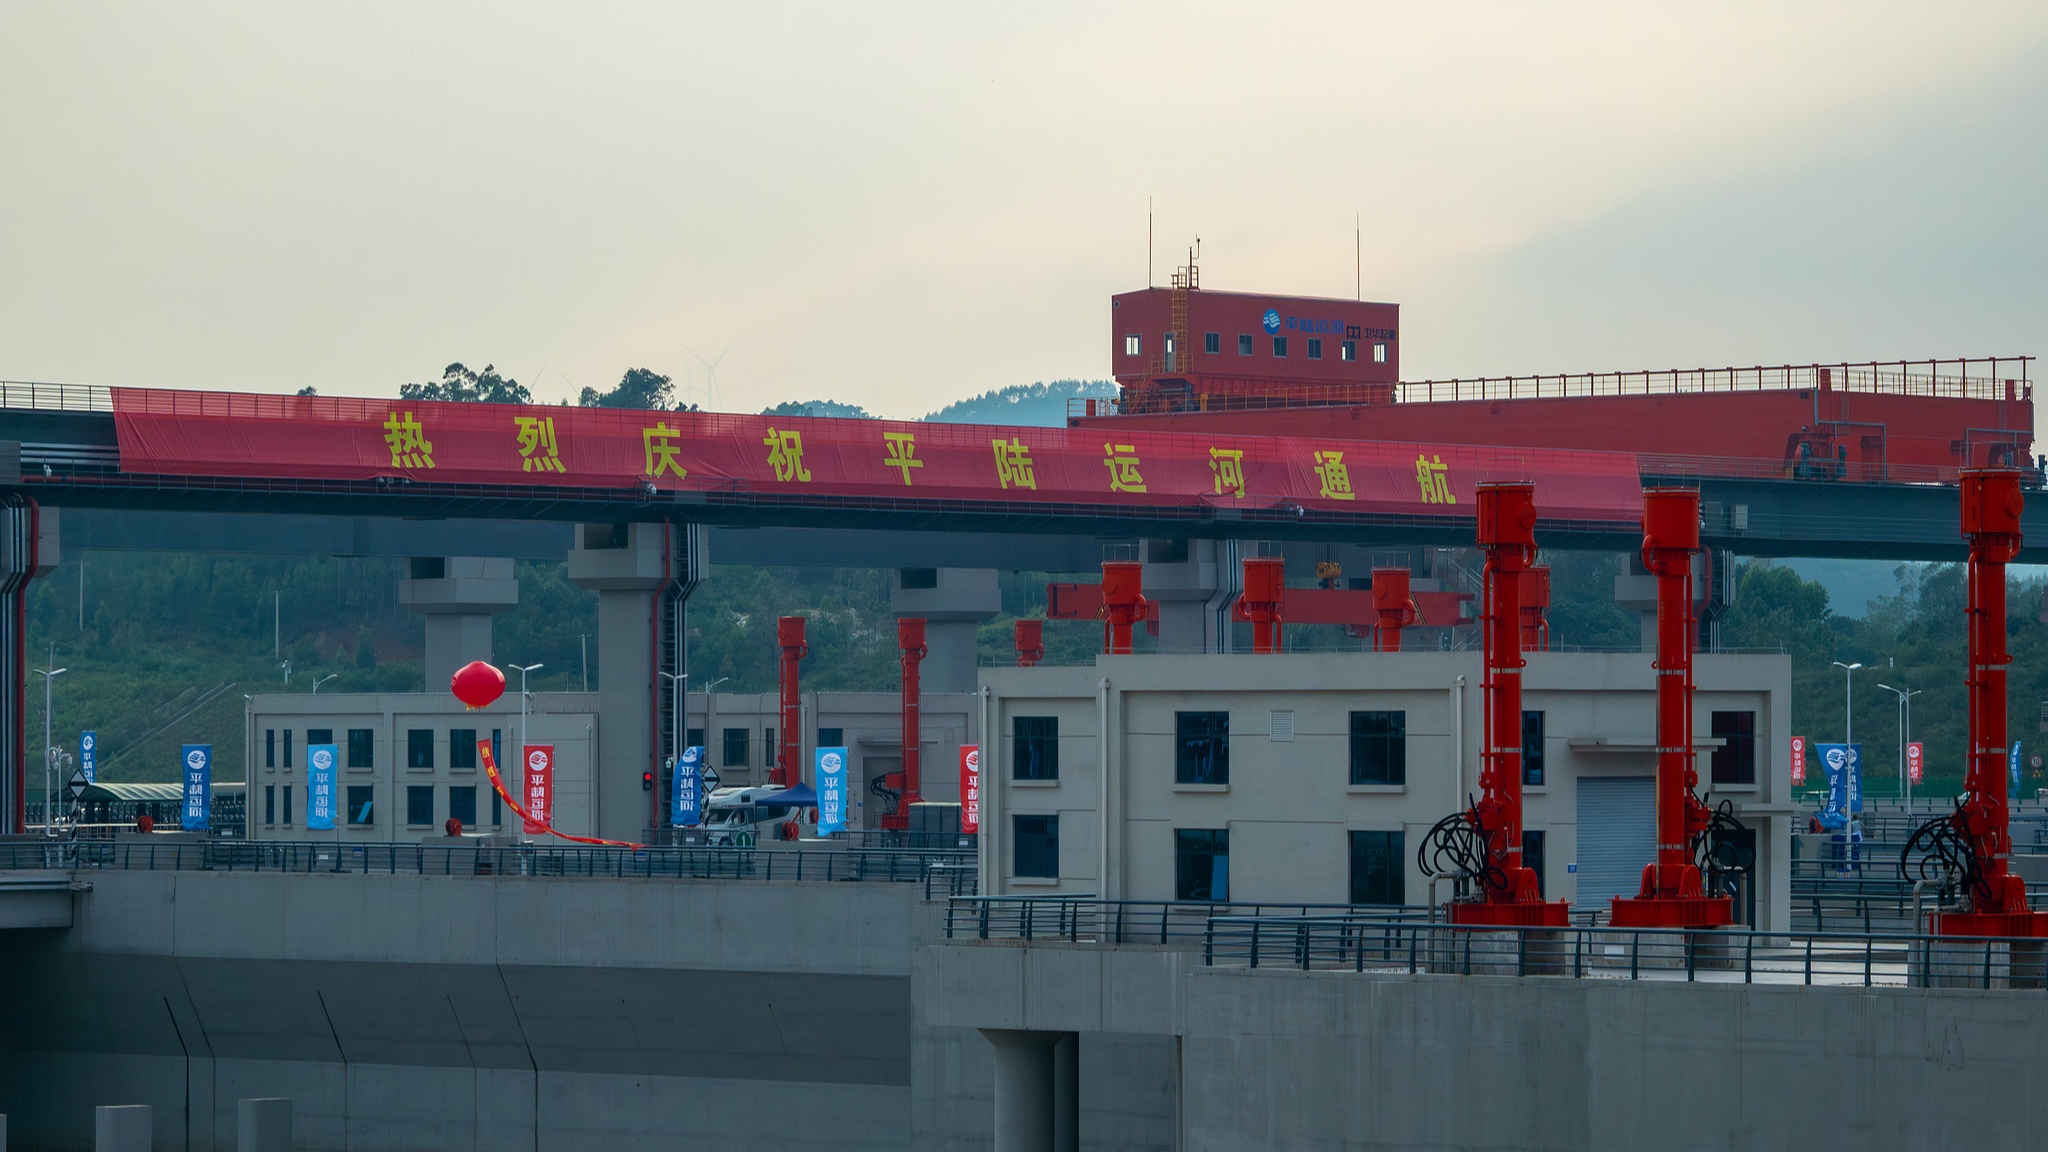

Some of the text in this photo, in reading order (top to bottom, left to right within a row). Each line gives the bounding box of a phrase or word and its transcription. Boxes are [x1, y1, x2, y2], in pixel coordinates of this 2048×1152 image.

[1285, 317, 1344, 335] 平陆运河
[383, 411, 1457, 506] 热烈庆祝平陆运河通航
